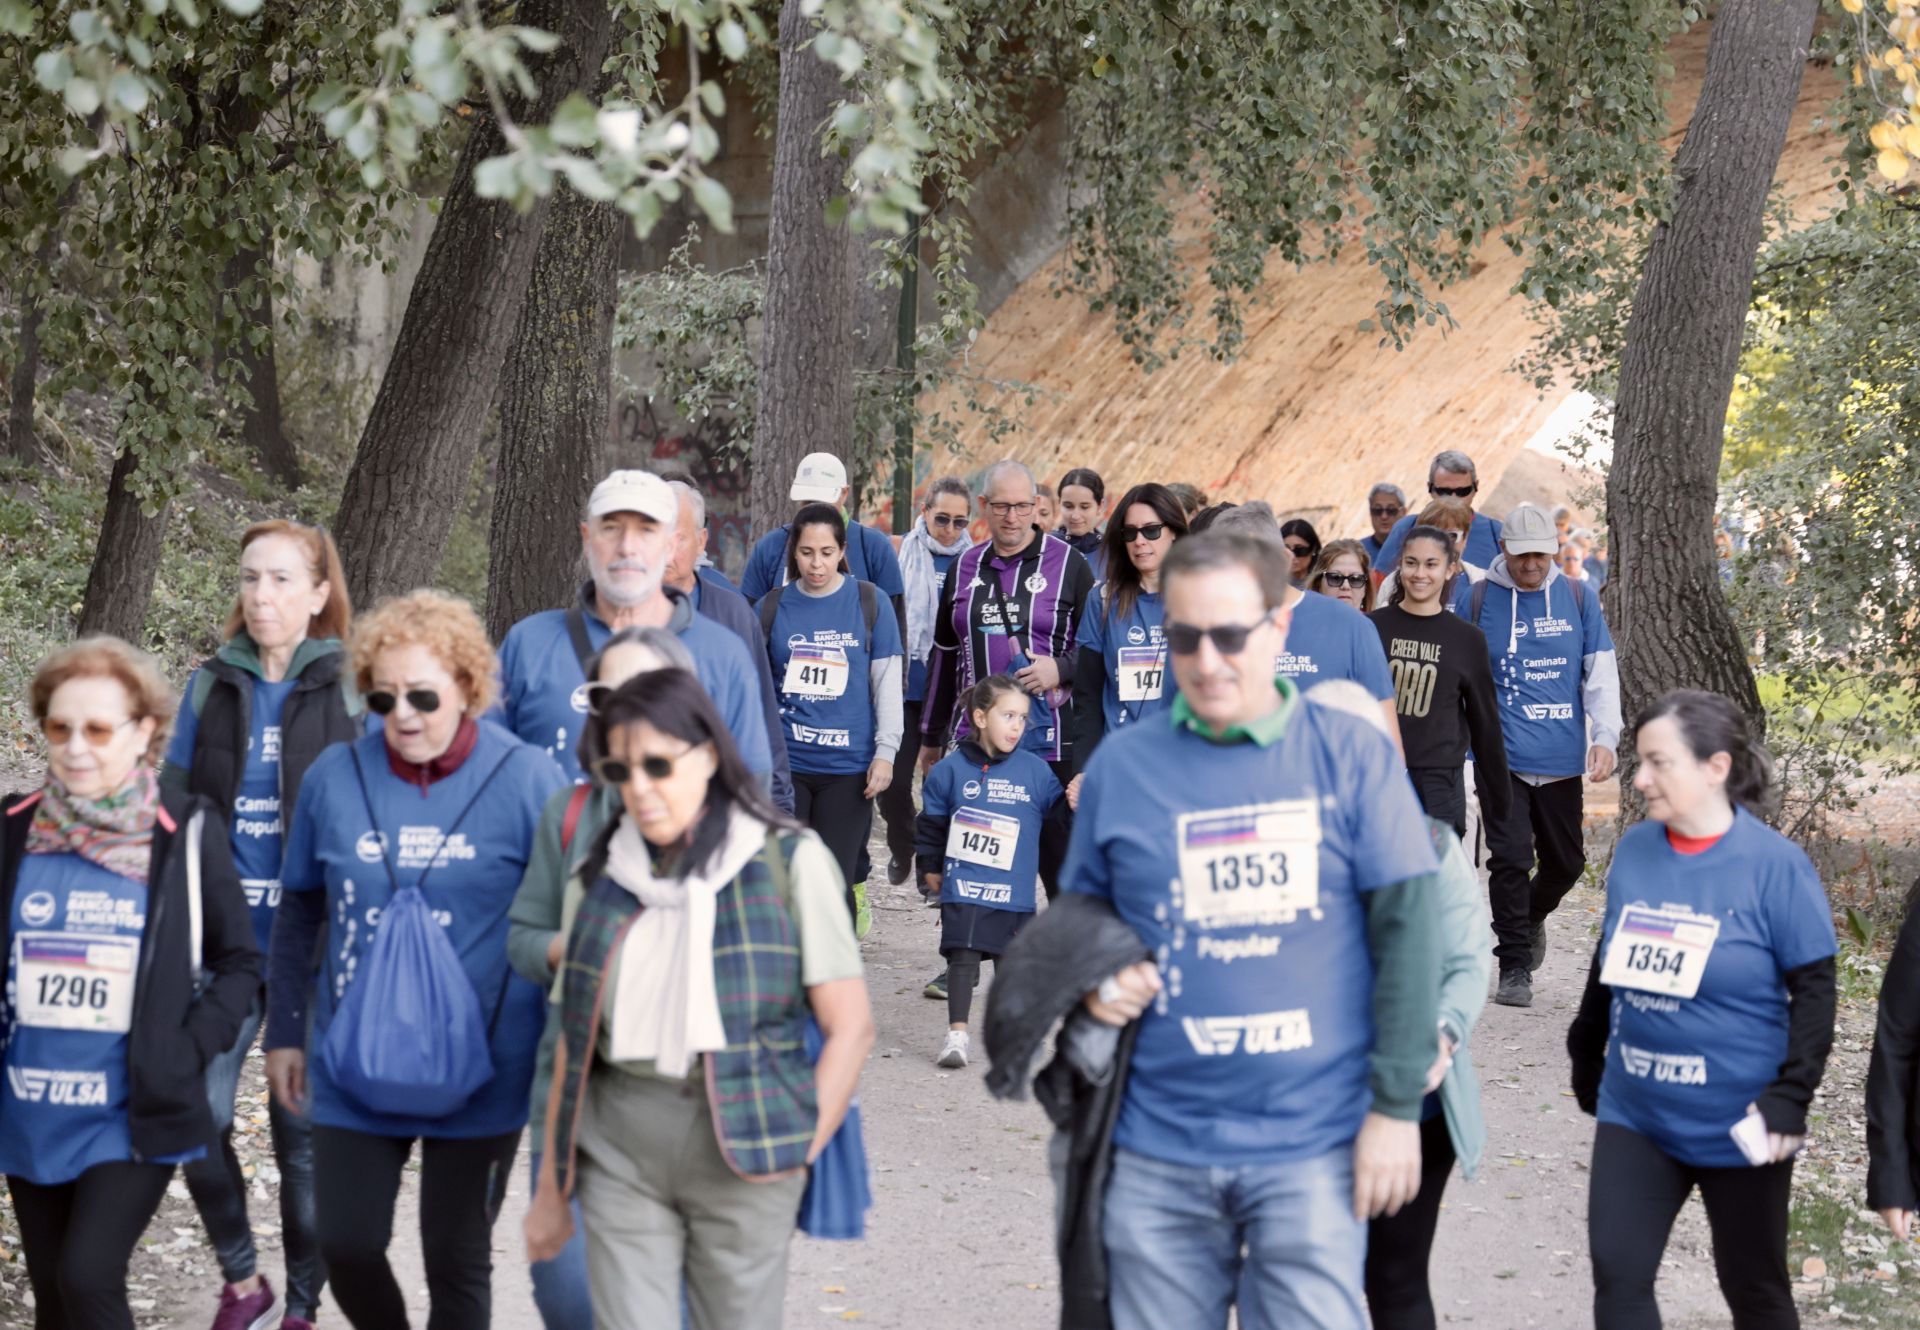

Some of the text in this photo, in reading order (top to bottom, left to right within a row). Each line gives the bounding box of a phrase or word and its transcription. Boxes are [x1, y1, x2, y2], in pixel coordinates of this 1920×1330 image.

[1534, 620, 1557, 628] BANCO
[1535, 625, 1573, 634] ALIMENTOS
[814, 633, 841, 642] BANCO
[1390, 638, 1442, 663] CREER VALE
[1297, 656, 1311, 664] DE
[1522, 657, 1567, 668] Caminata
[800, 665, 828, 685] 411
[1525, 670, 1561, 682] Popular
[1389, 659, 1438, 718] ORO
[1549, 708, 1573, 719] ULSA
[817, 734, 850, 747] ULSA
[987, 783, 1026, 793] BANCO DE
[987, 790, 1031, 802] ALIMENTOS
[962, 831, 1001, 856] 1475
[1205, 850, 1289, 893] 1353
[982, 889, 1012, 904] ULSA
[115, 899, 136, 914] DE
[65, 910, 146, 930] ALIMENTOS
[1197, 933, 1281, 963] Popular
[1626, 942, 1686, 977] 1354
[37, 974, 109, 1010] 1296
[1653, 1060, 1707, 1086] ULSA
[48, 1079, 108, 1106] ULSA
